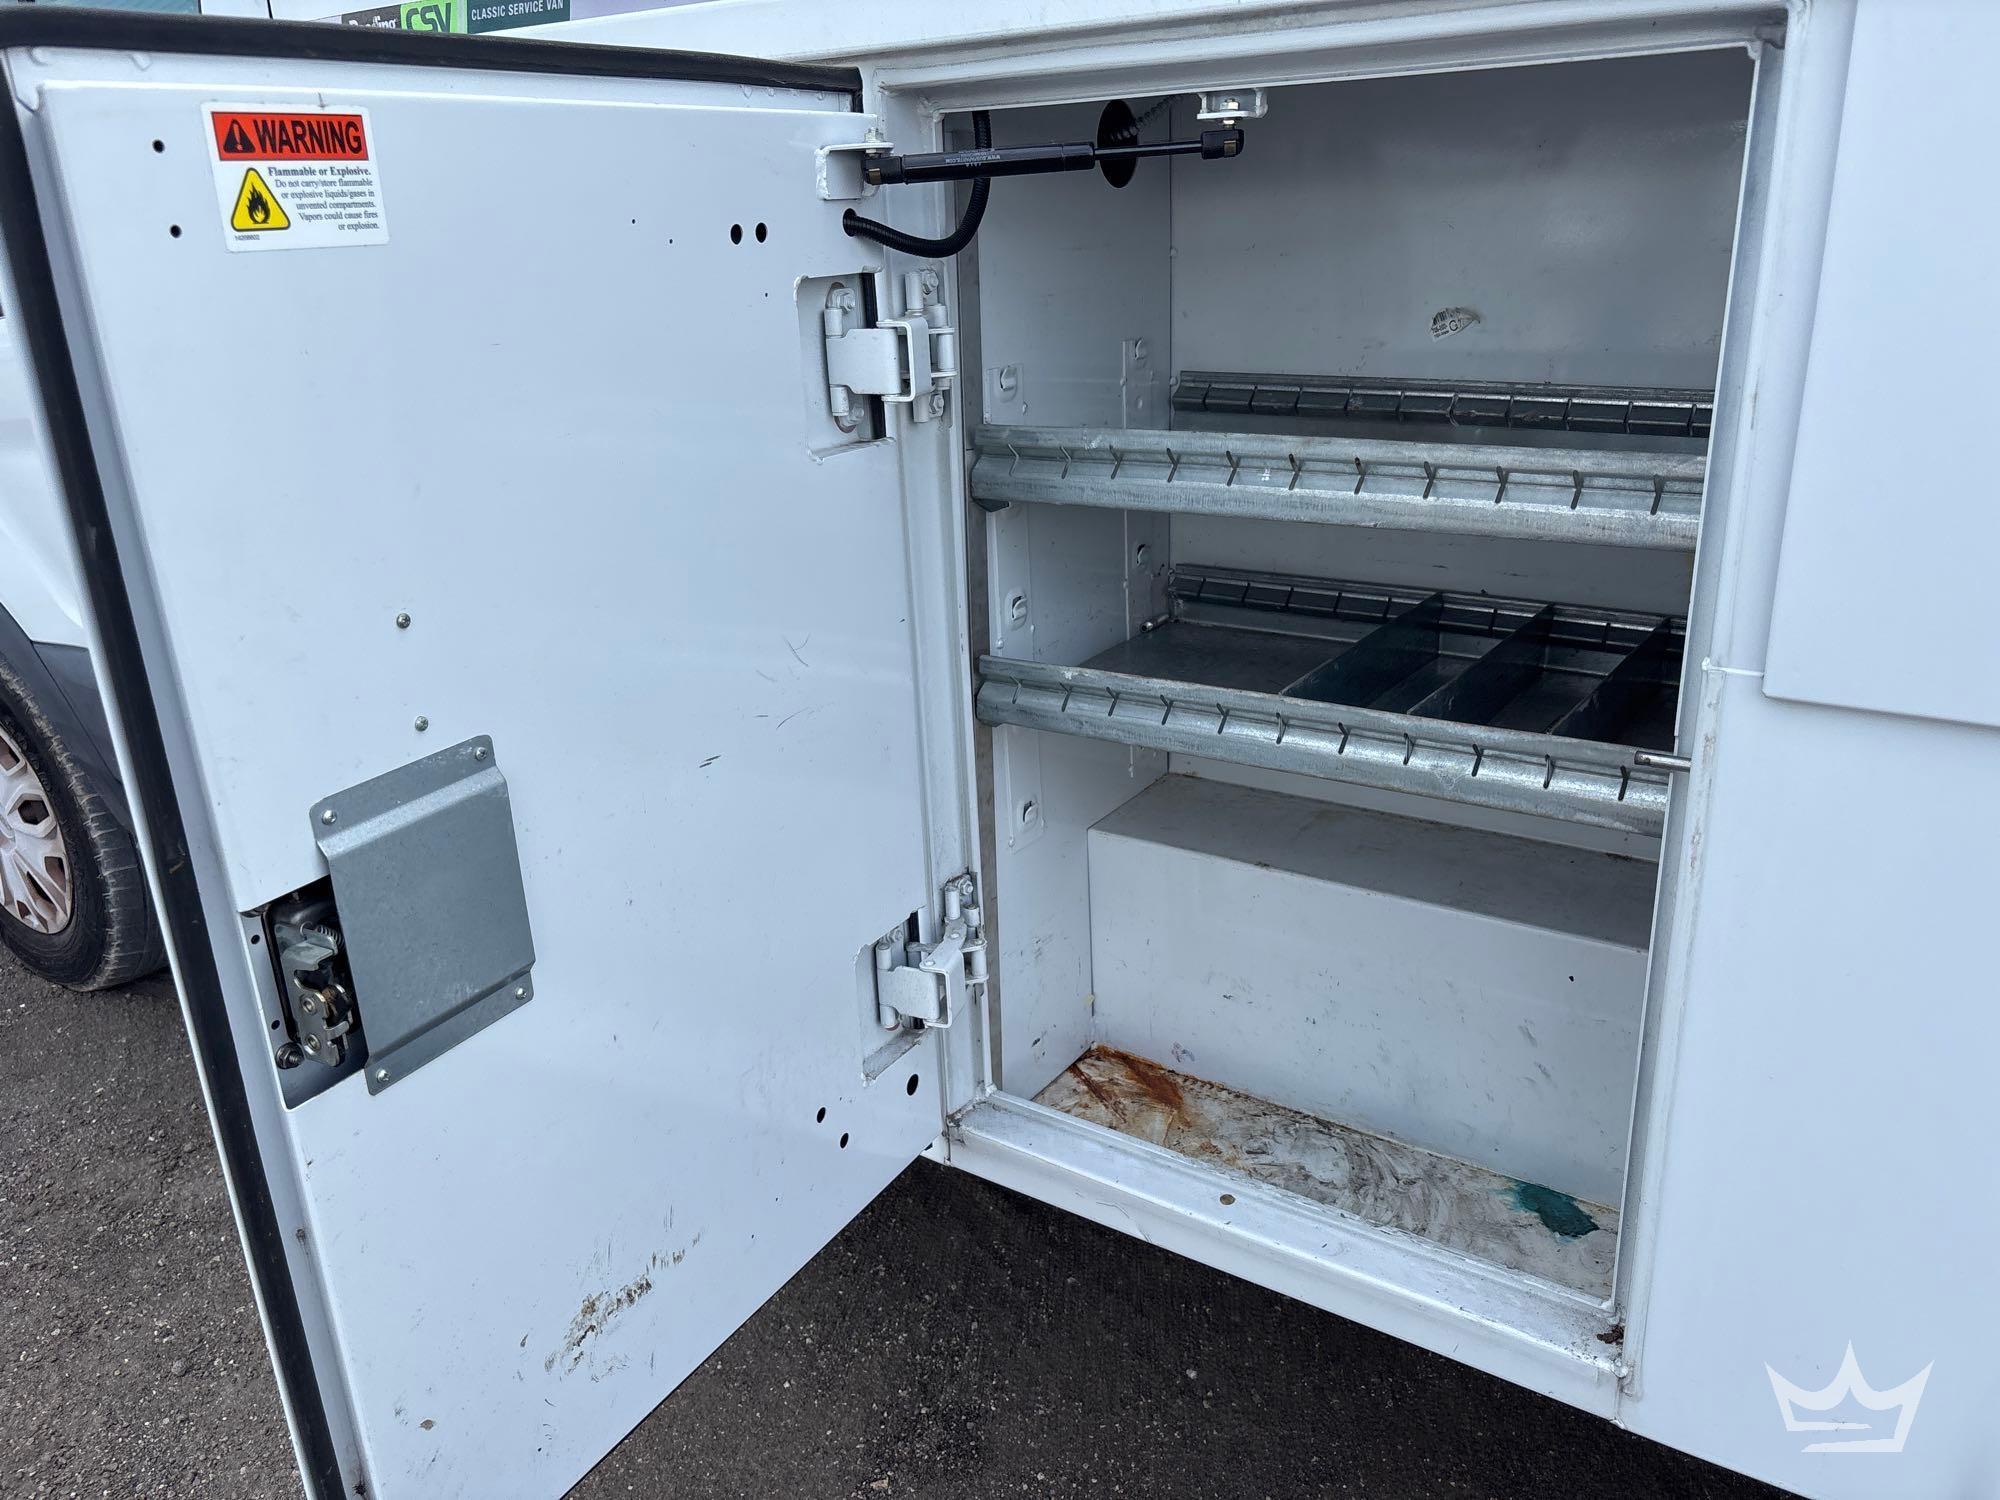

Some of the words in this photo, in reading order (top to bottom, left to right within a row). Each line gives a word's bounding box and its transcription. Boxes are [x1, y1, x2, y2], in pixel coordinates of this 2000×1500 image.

[471, 5, 506, 20] CLASSIC
[508, 0, 544, 16] SERVICE
[546, 0, 564, 11] VAN
[406, 2, 452, 33] CSV
[252, 119, 362, 154] WARNING
[268, 167, 316, 177] Flammable
[330, 167, 371, 179] Explosive.
[275, 179, 286, 188] Do
[288, 180, 300, 188] not
[339, 178, 373, 187] flammable
[290, 190, 323, 201] explosive
[368, 189, 375, 197] in
[296, 201, 327, 210] unvented
[329, 200, 376, 211] compartments.
[299, 212, 323, 223] Vapors
[324, 212, 343, 220] could
[344, 212, 362, 220] cause
[363, 211, 378, 219] fires
[347, 221, 380, 232] explosion.
